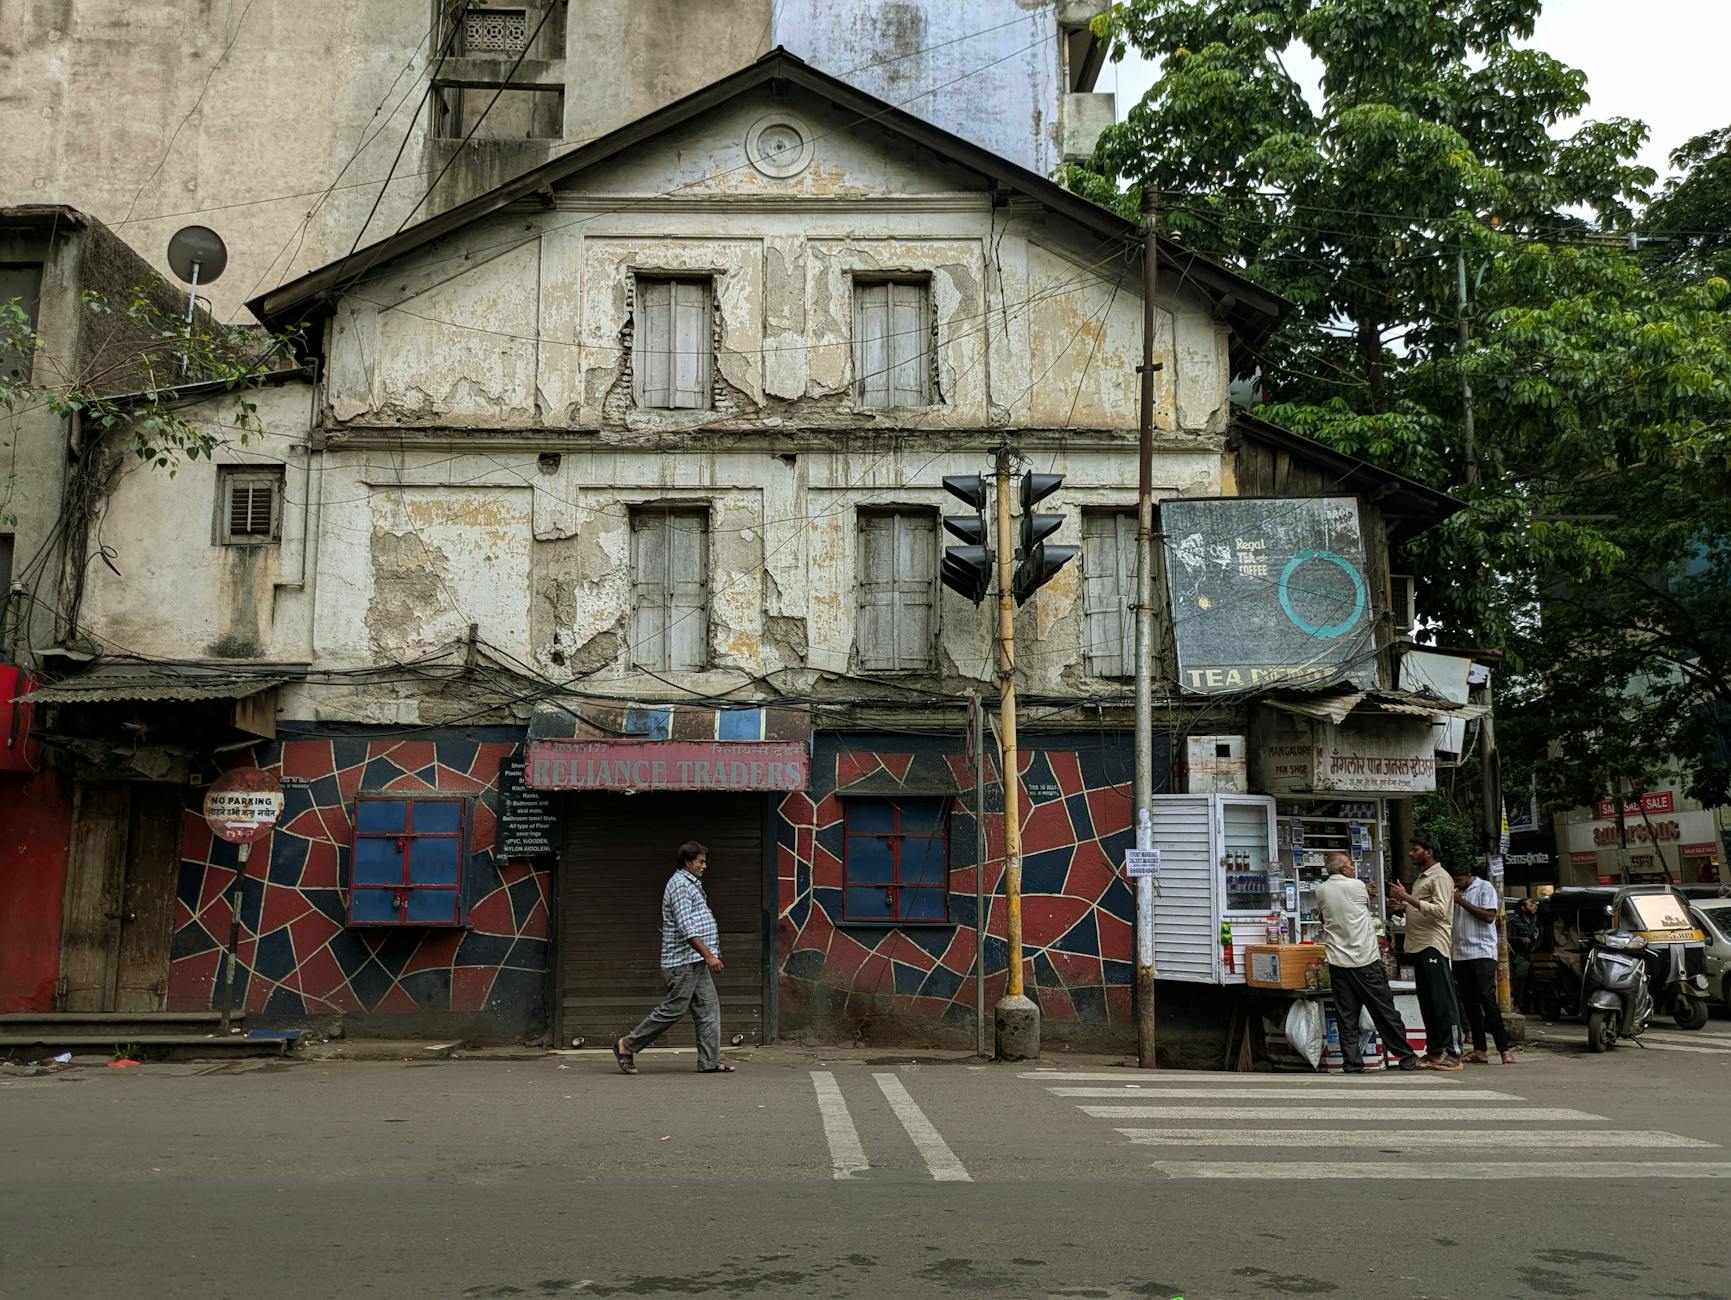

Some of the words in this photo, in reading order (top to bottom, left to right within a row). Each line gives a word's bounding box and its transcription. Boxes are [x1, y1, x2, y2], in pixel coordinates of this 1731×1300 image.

[1235, 538, 1266, 551] Regal
[1237, 552, 1256, 563] TEA
[1239, 564, 1268, 576] COFFEE
[1187, 668, 1245, 687] TEA
[1269, 745, 1312, 758] MANGALORE
[1366, 757, 1383, 775] पान
[533, 759, 667, 786] RELIANCE
[677, 759, 801, 787] TRADERS
[211, 796, 226, 805] NO
[228, 797, 272, 806] PARKING
[1646, 796, 1668, 810] SALE
